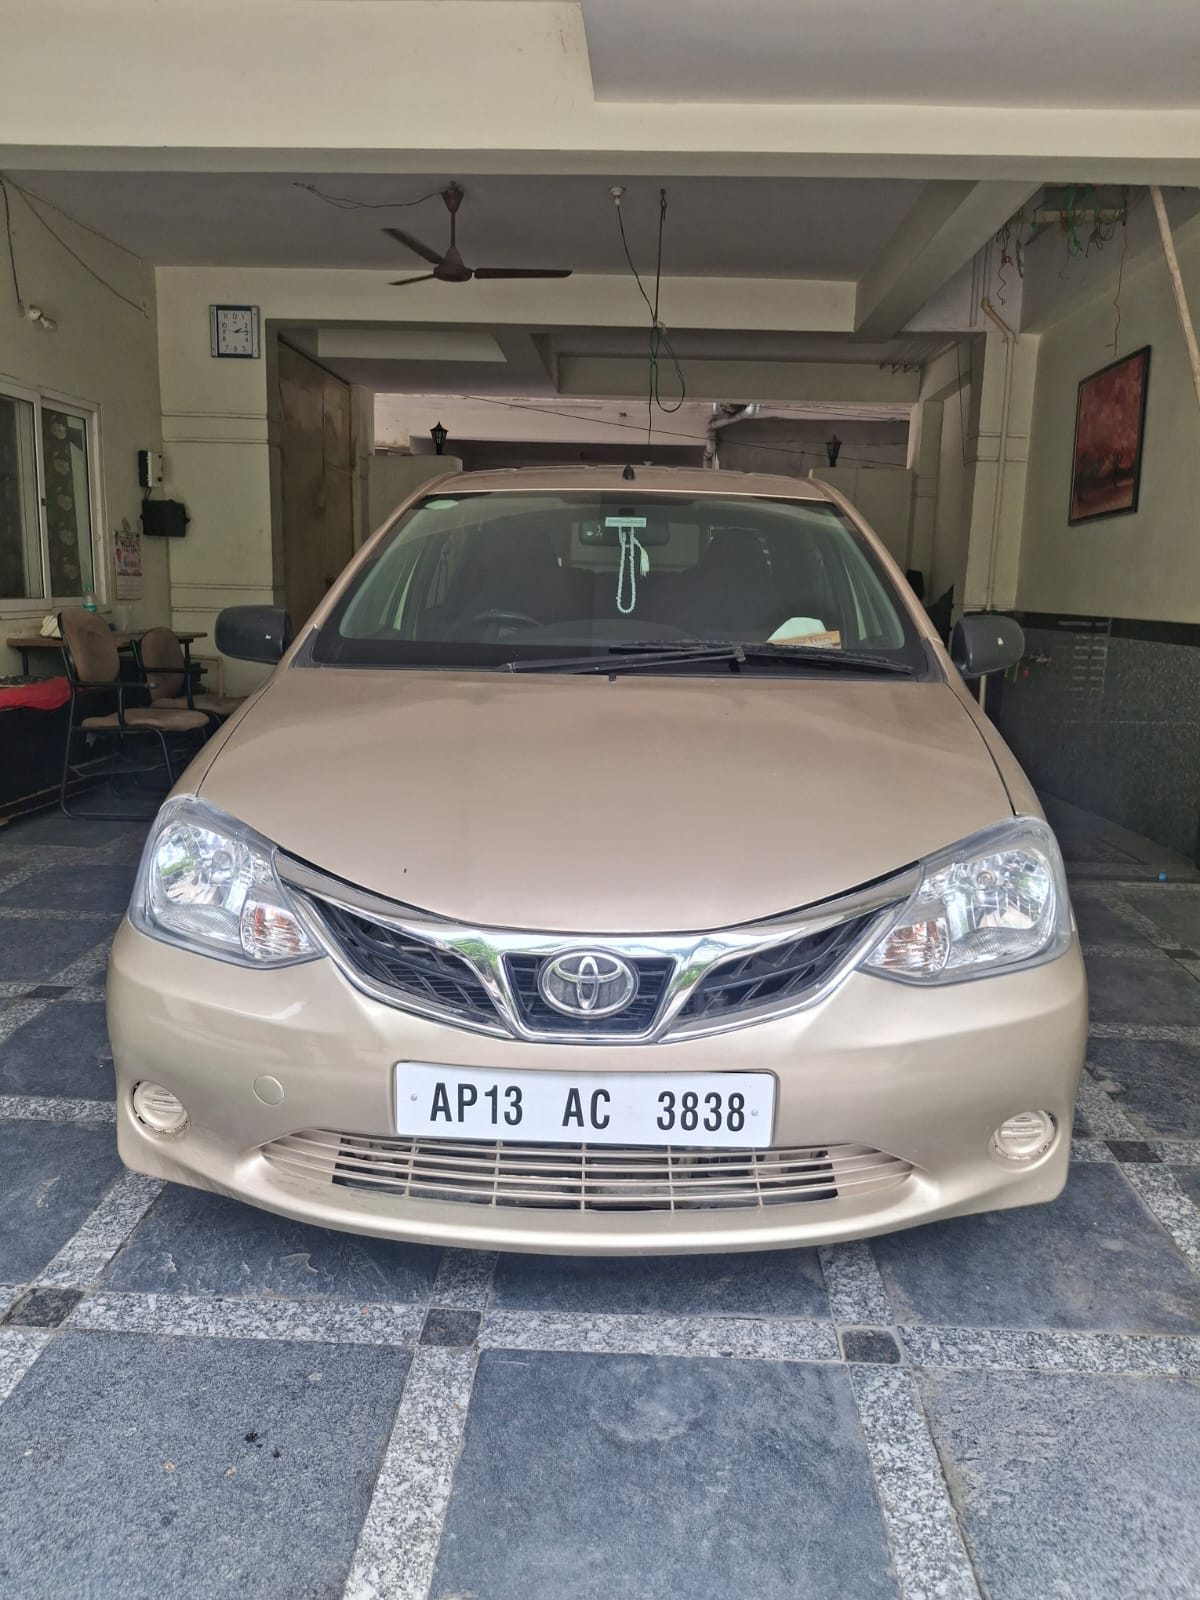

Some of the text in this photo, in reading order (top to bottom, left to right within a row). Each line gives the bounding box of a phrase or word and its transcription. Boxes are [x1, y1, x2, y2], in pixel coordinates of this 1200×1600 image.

[430, 1082, 746, 1132] AP13 AC 3838
